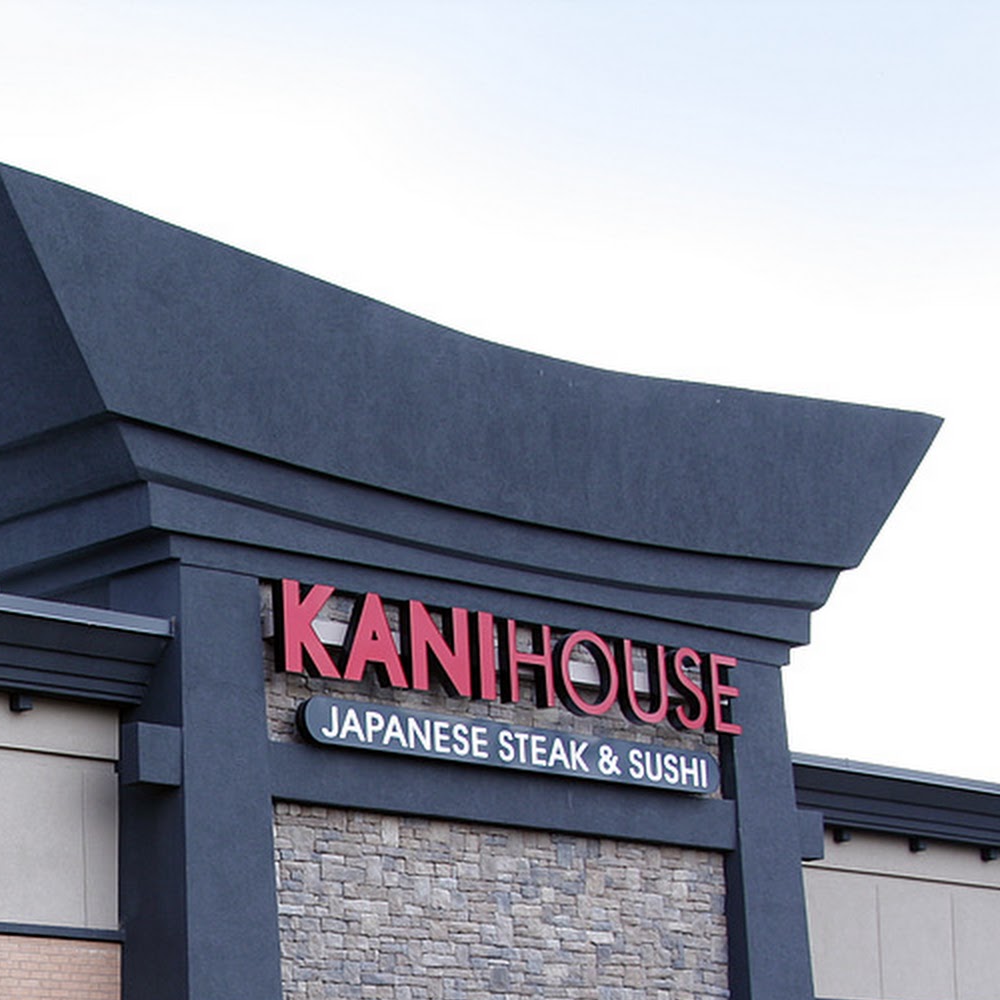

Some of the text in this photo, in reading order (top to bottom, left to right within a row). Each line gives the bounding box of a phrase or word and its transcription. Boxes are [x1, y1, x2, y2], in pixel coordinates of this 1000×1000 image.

[321, 705, 709, 789] JAPANESE STEAK & SUSHI
